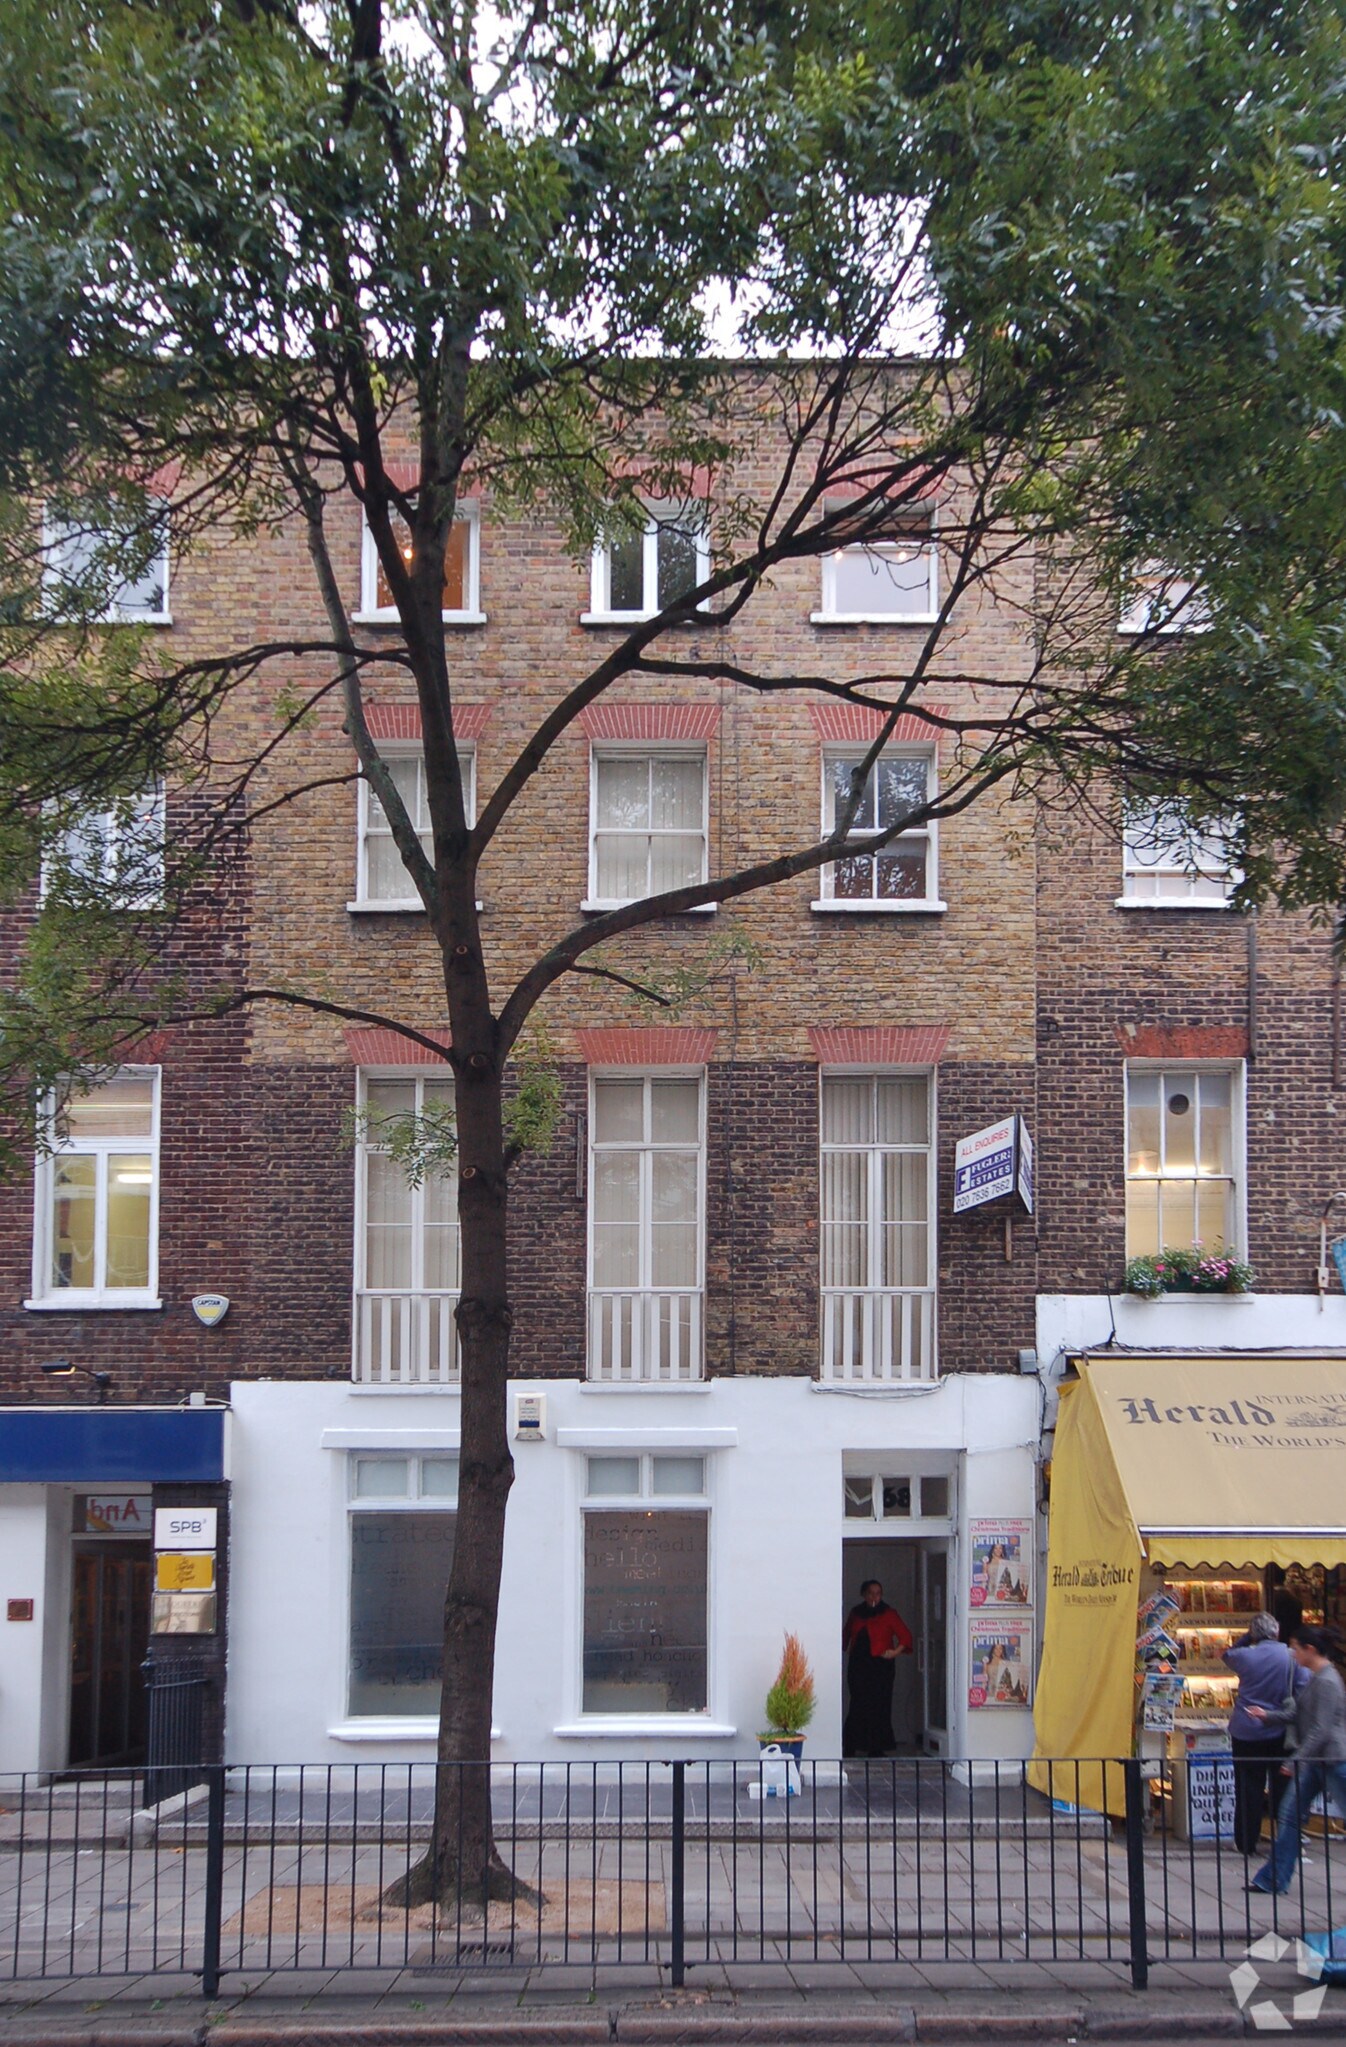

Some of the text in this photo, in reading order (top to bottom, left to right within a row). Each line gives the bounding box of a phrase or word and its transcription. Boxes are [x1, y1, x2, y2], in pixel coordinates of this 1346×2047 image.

[962, 1145, 973, 1157] ALL
[971, 1164, 1011, 1187] ESTATES
[1255, 1394, 1346, 1405] INTERNATI
[1117, 1397, 1276, 1427] Herald
[973, 1535, 1009, 1548] prima
[1053, 1565, 1080, 1587] Herald
[973, 1635, 1009, 1648] prima
